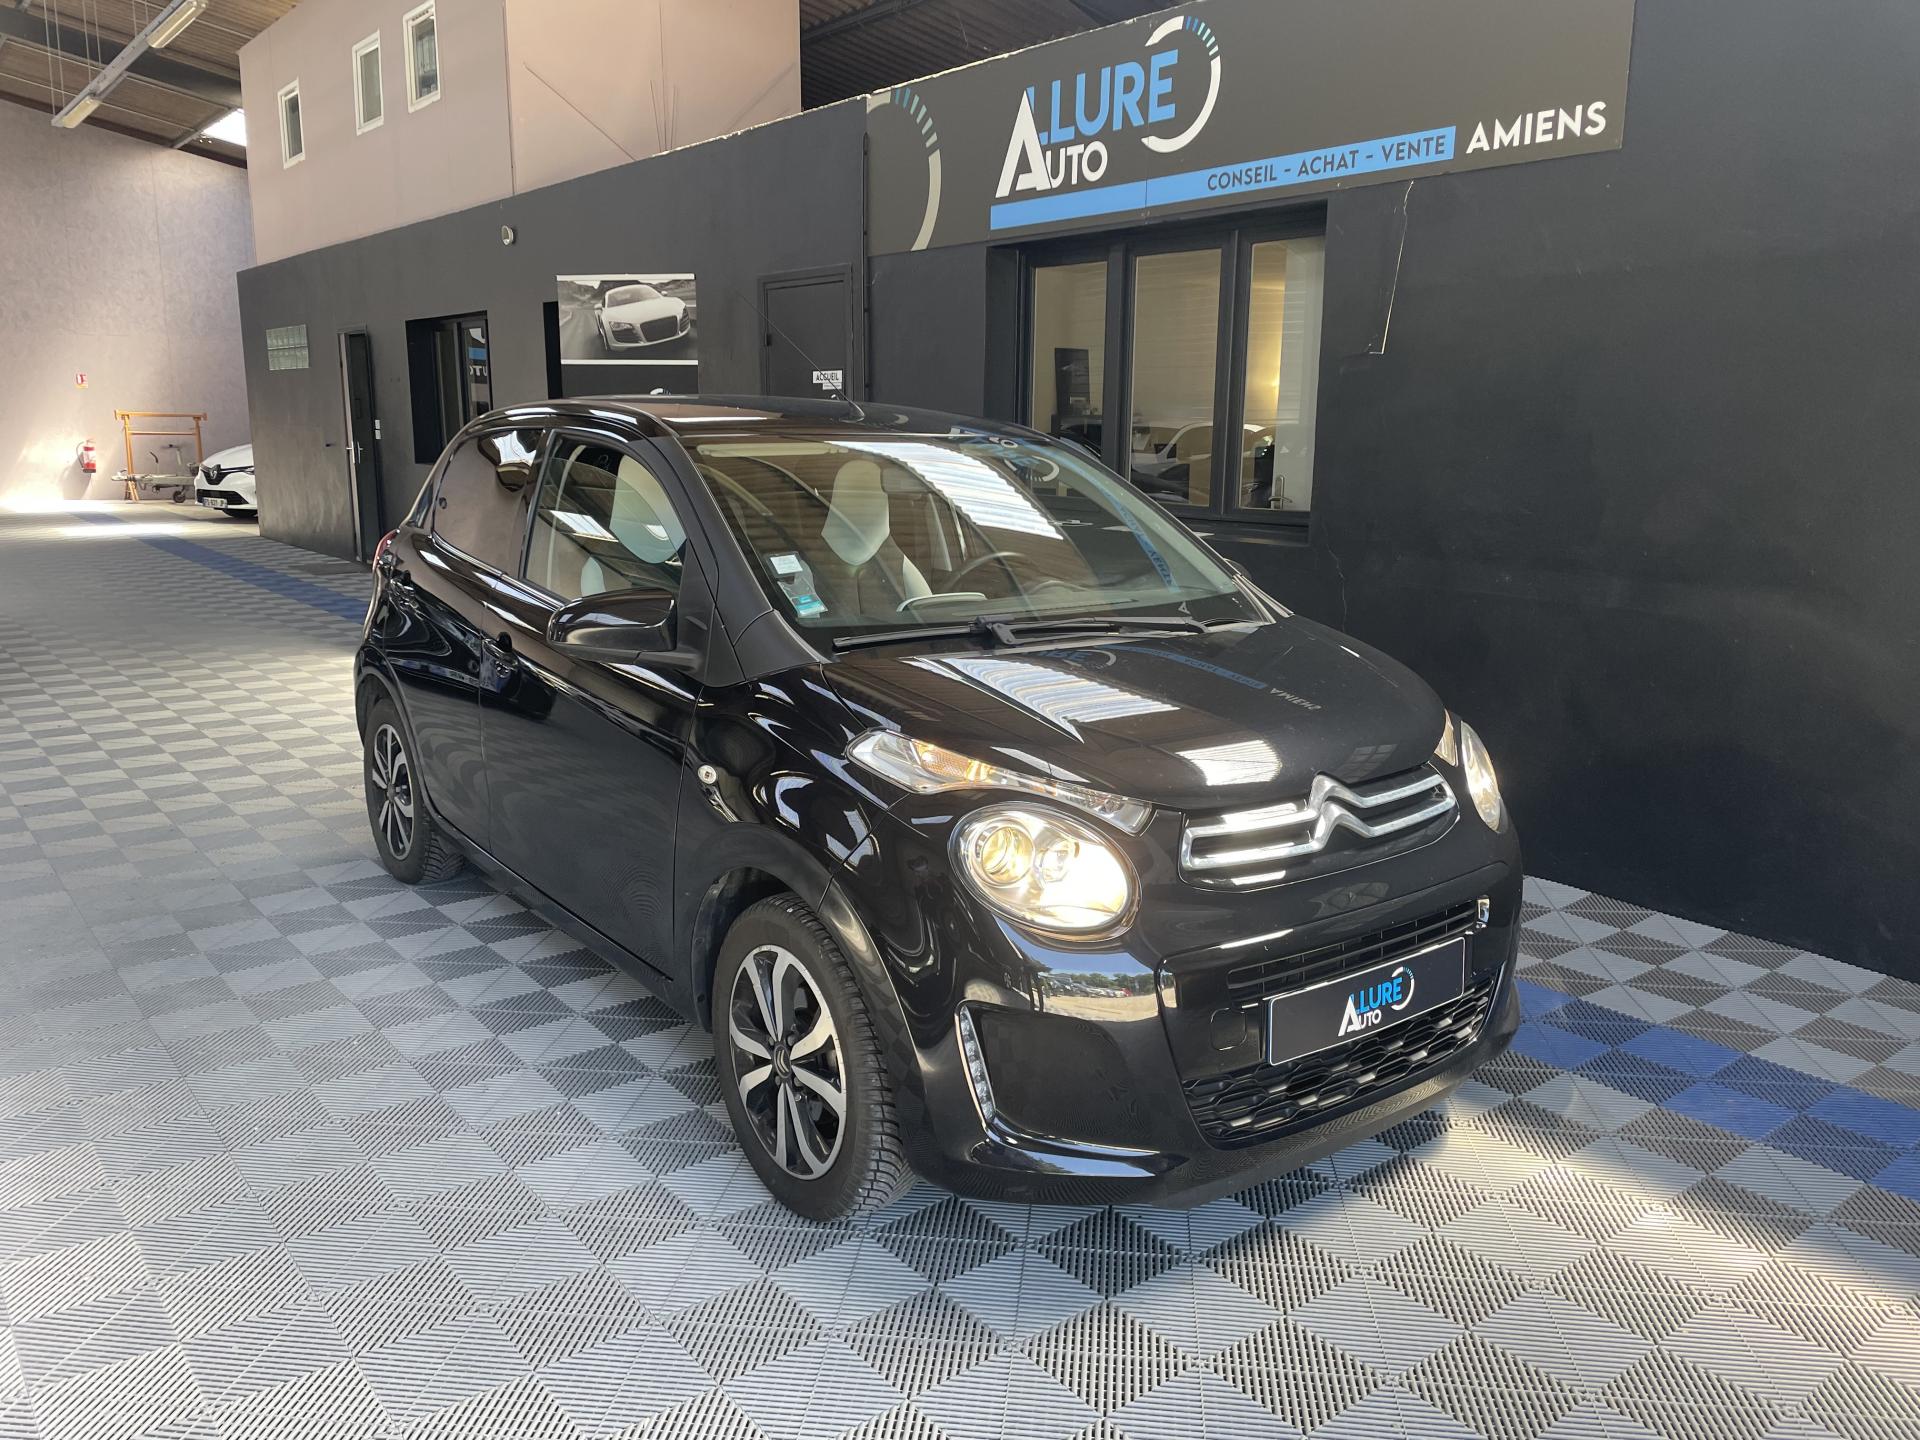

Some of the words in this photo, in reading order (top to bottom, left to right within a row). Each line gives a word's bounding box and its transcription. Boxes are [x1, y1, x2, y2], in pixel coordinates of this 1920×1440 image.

[996, 90, 1108, 198] AUTO
[1466, 101, 1607, 154] AMIENS
[1207, 164, 1277, 191] CONSEIL
[1297, 150, 1359, 176] ACHAT
[1382, 135, 1446, 162] VENTE
[816, 372, 839, 382] ACCUEIL
[1338, 994, 1382, 1036] AUTO
